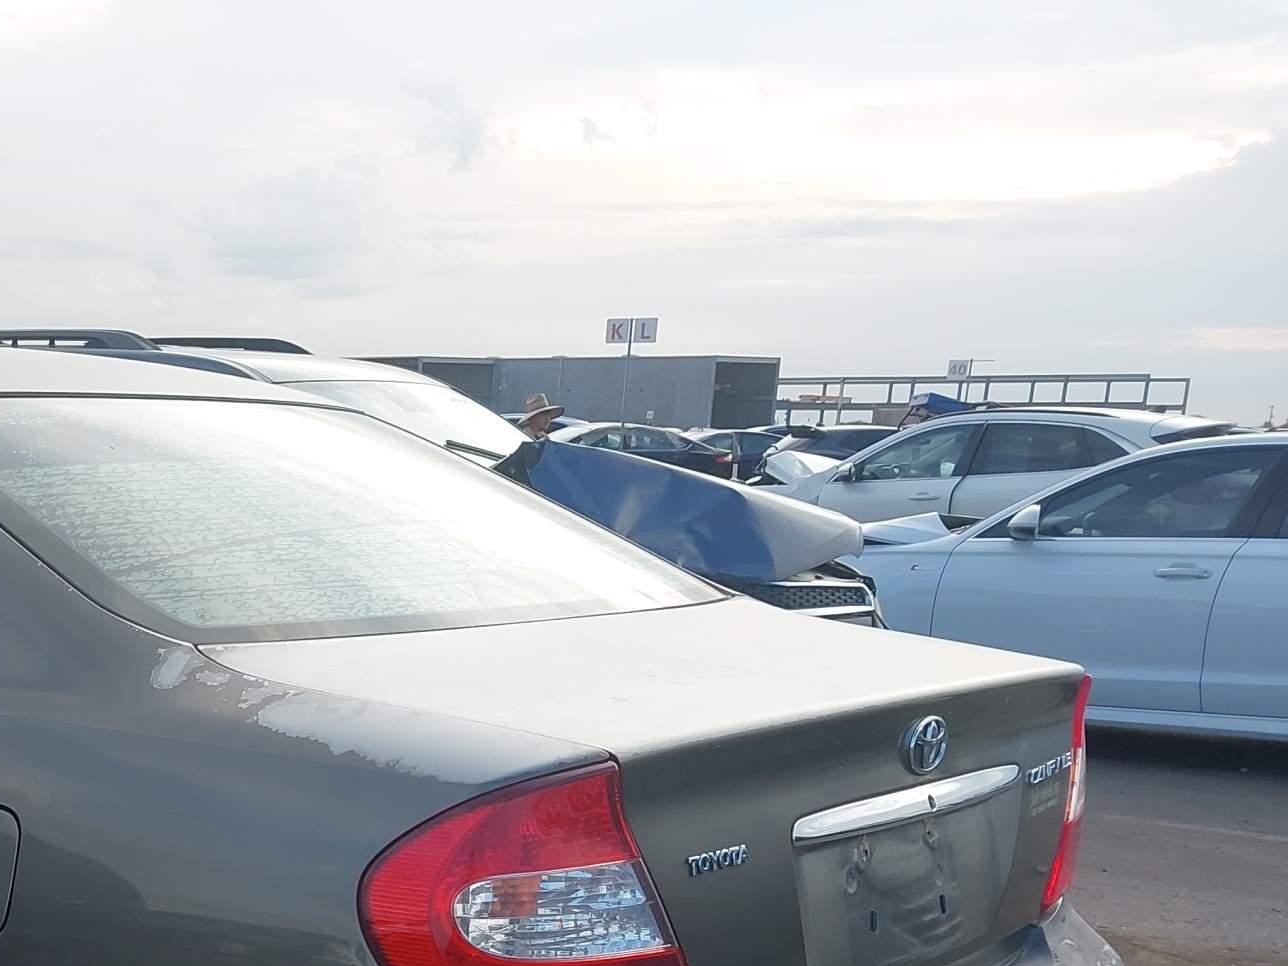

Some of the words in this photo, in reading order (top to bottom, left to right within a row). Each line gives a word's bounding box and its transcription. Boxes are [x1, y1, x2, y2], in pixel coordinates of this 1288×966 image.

[612, 323, 623, 340] K
[641, 323, 650, 339] L
[949, 364, 967, 376] 40
[687, 844, 748, 876] TOYOTA
